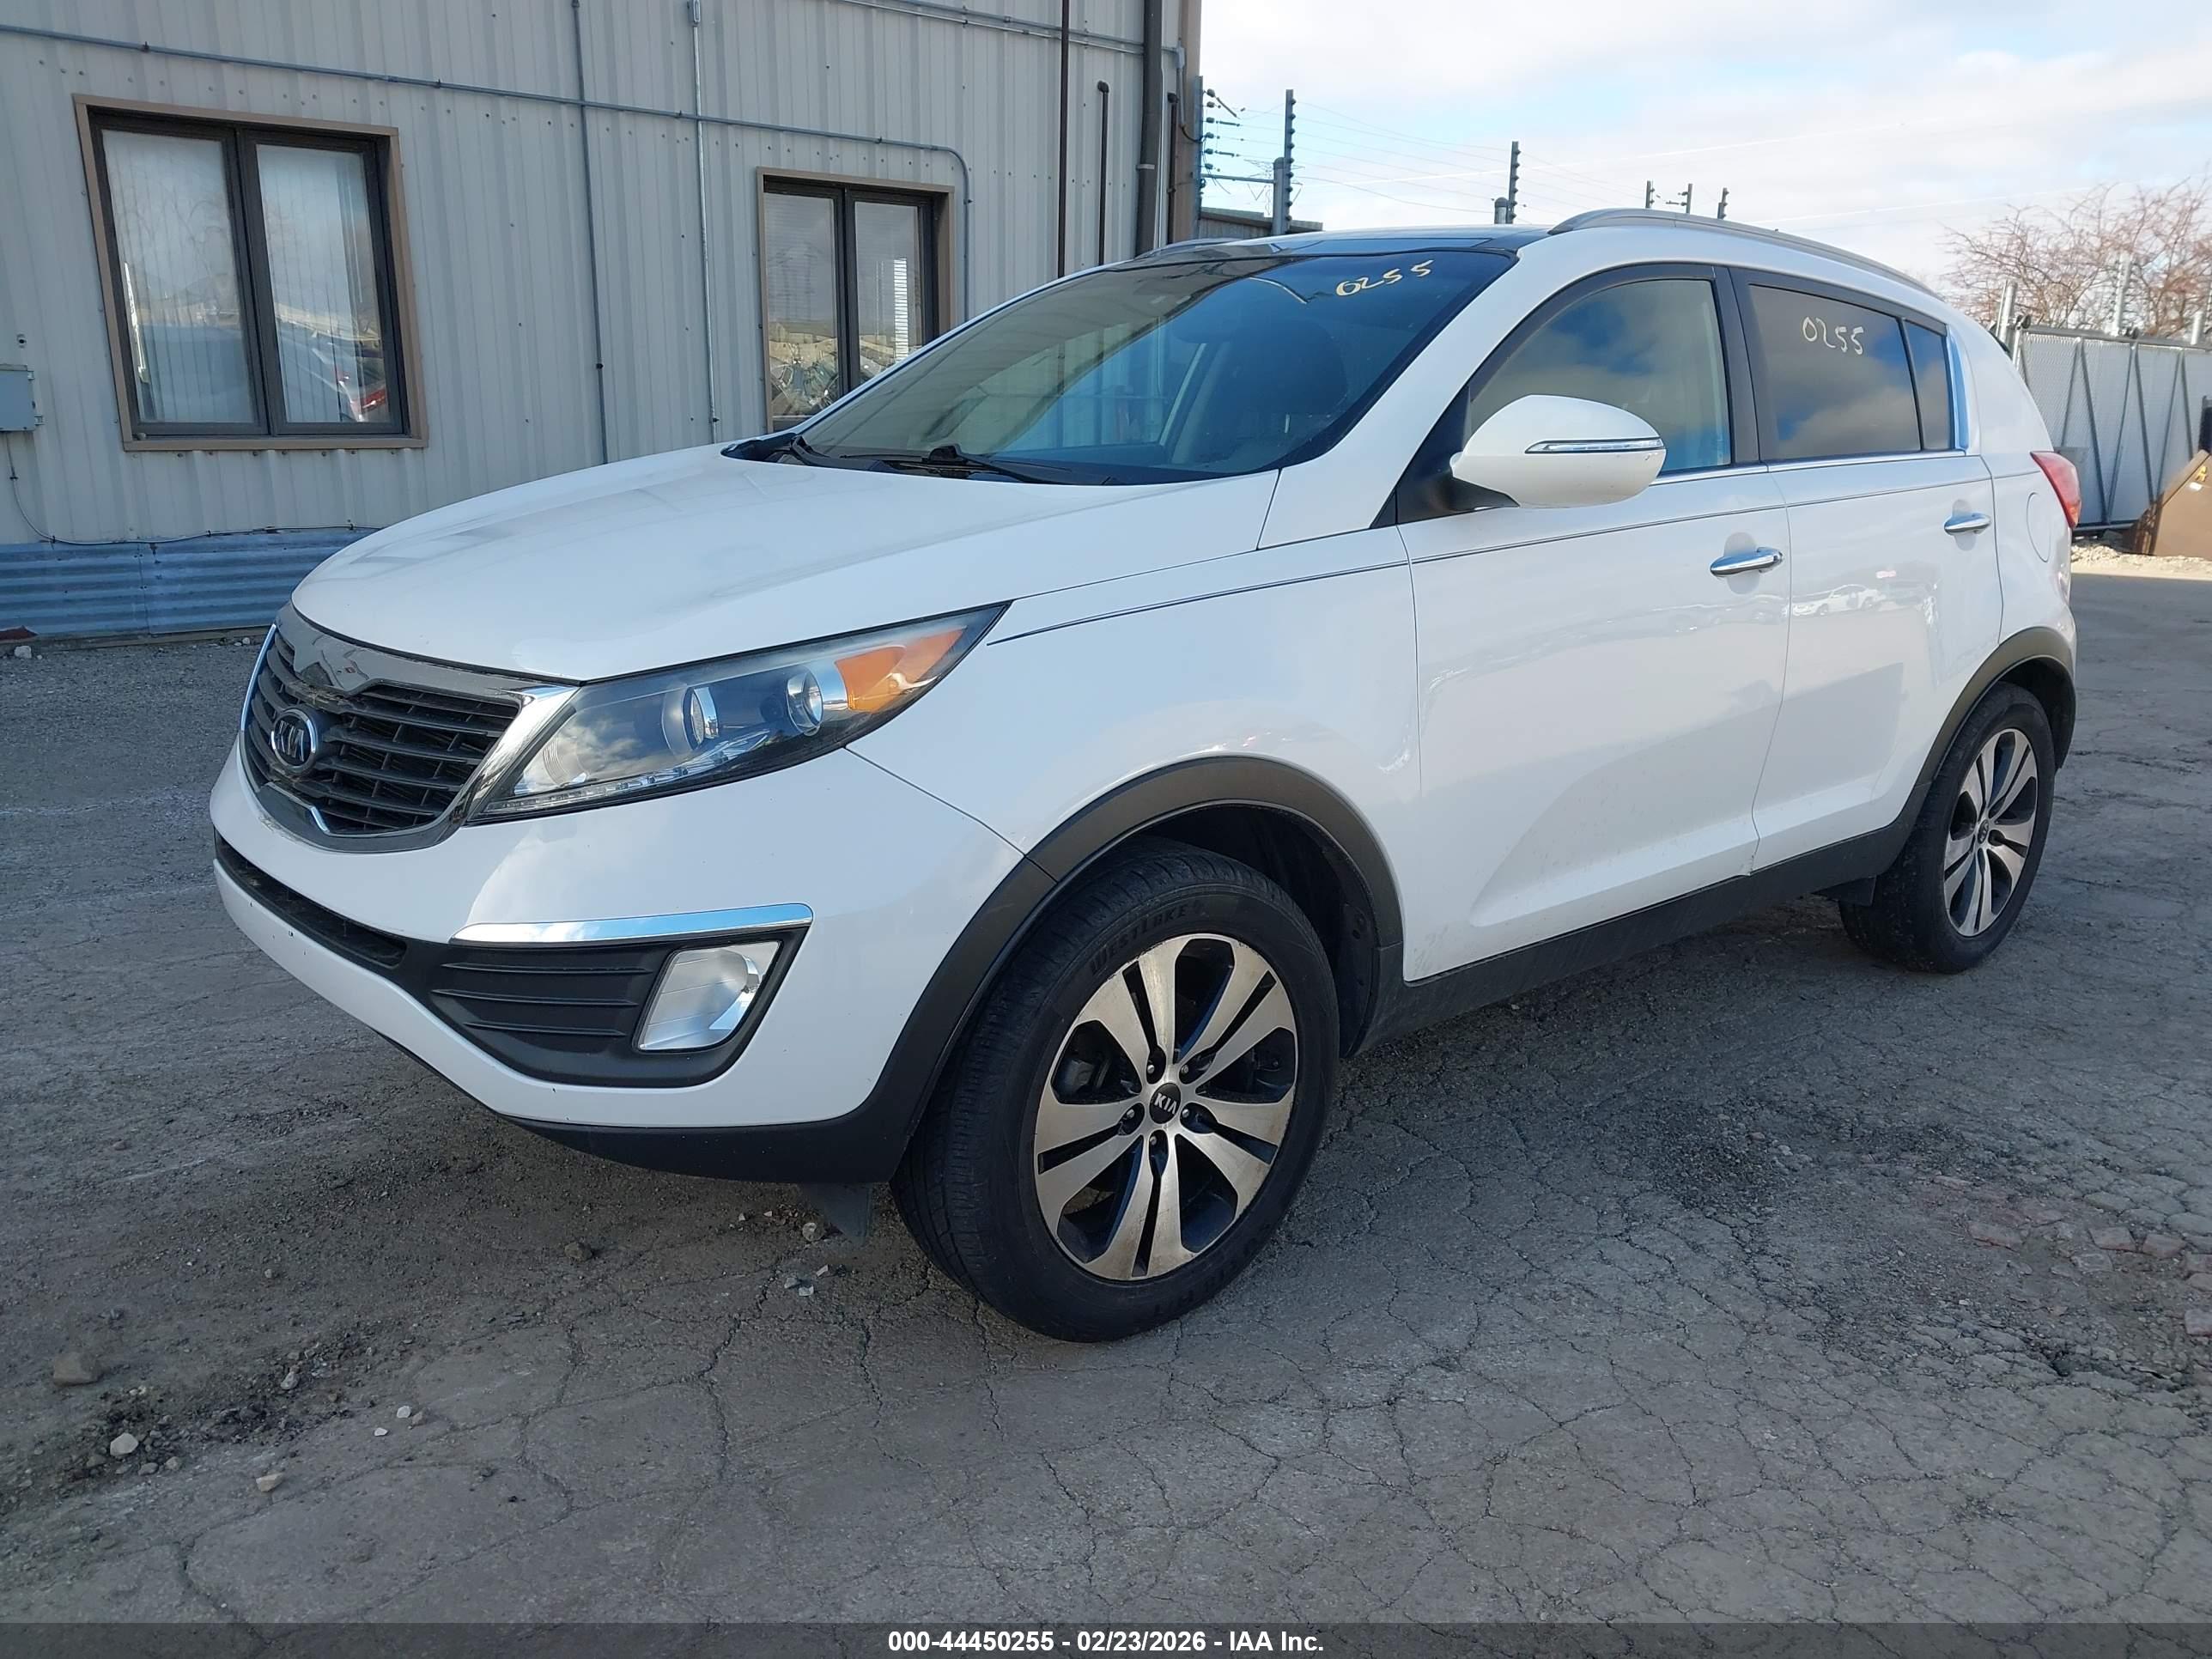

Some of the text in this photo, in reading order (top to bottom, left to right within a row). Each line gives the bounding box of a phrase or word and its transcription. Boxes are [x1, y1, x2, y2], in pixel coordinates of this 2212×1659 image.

[1335, 259, 1433, 295] 0255
[1802, 316, 1863, 354] 0255
[1154, 1092, 1177, 1115] KIA
